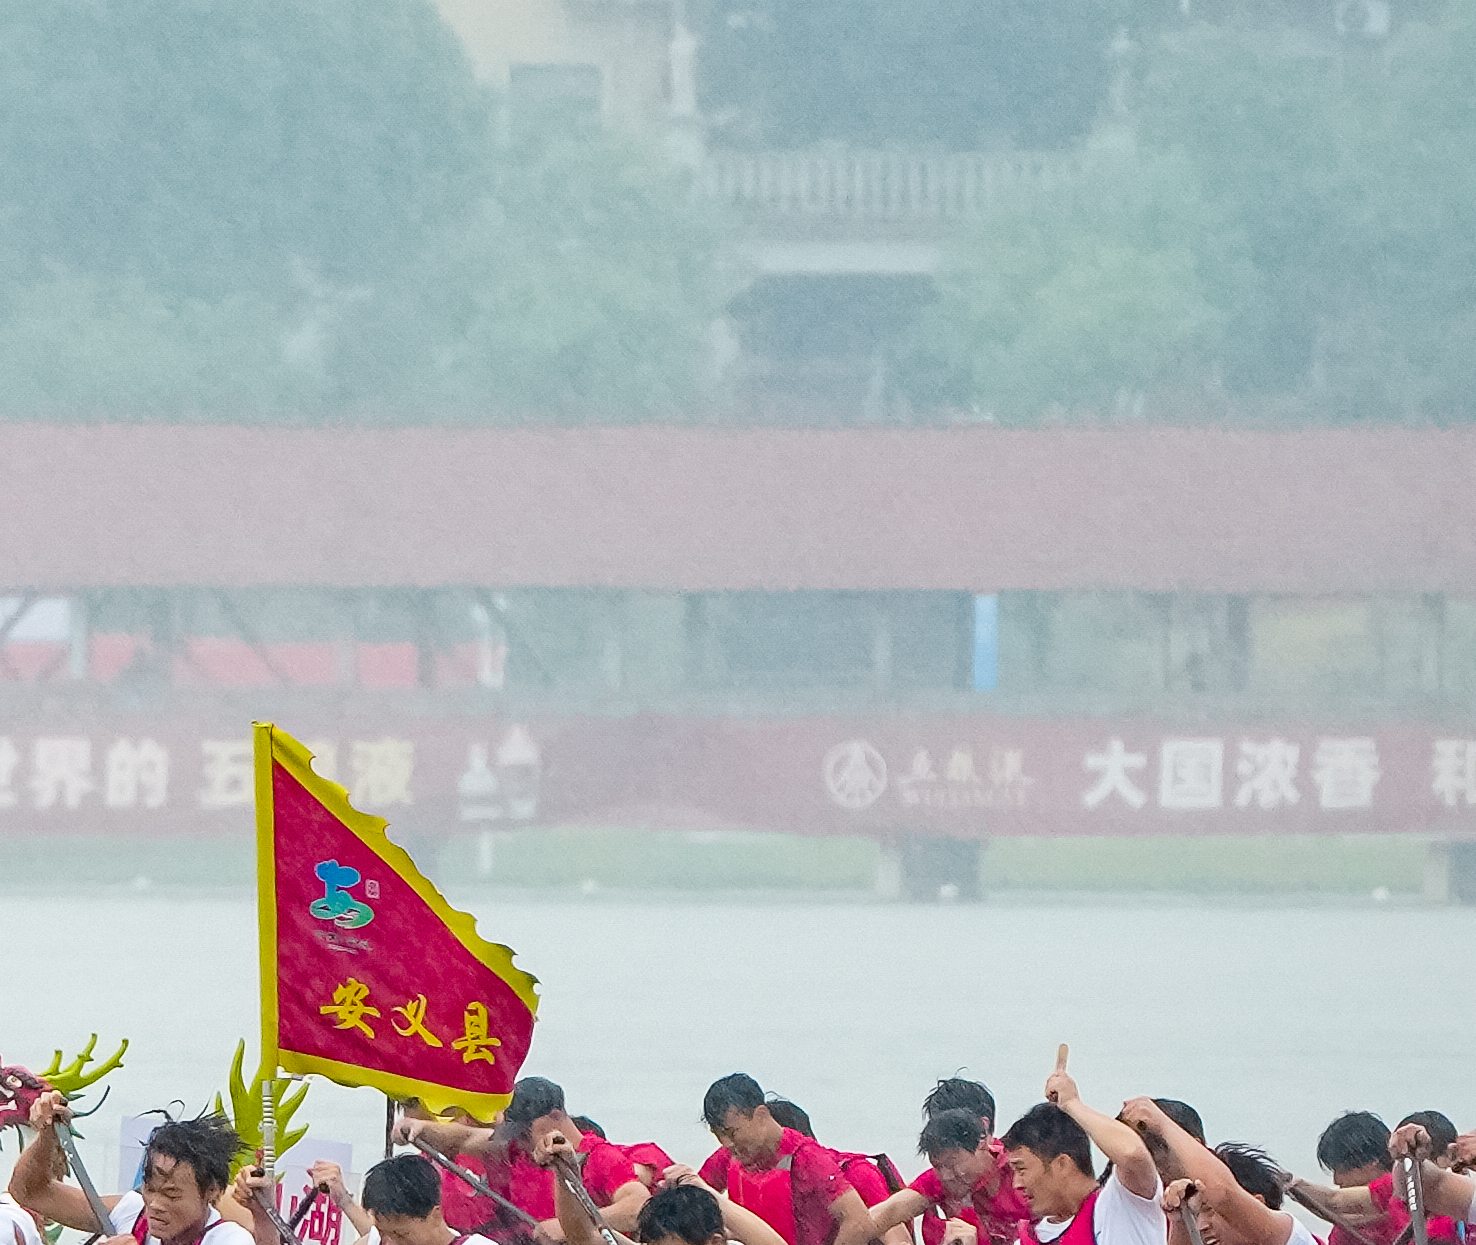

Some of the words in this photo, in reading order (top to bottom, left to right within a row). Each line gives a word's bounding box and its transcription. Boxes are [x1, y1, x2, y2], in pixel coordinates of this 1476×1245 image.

[199, 738, 416, 809] 五液
[1083, 735, 1382, 810] 大国浓香
[319, 977, 501, 1065] 安义县
